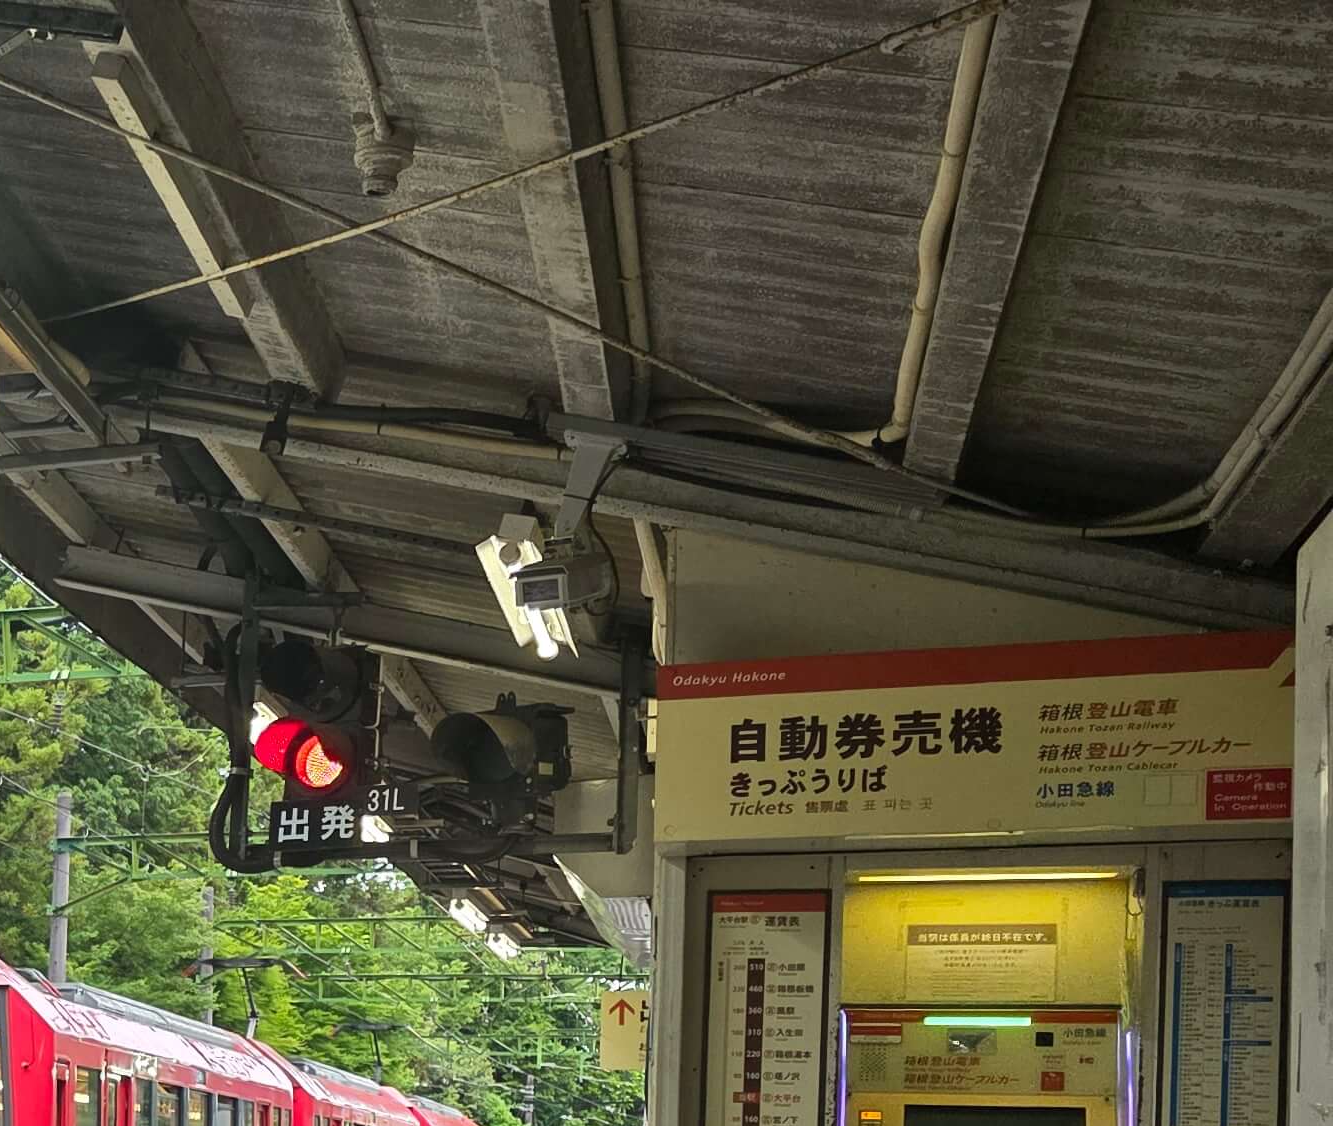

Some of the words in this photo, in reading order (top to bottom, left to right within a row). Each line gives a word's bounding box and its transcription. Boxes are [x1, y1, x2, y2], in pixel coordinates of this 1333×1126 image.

[673, 674, 727, 687] Odakyu
[733, 671, 786, 683] Hakone
[1038, 698, 1180, 722] 箱根登山電車
[730, 706, 1003, 763] 自動券売機
[1040, 725, 1084, 735] Hakone
[1089, 723, 1123, 733] Tozan
[1127, 720, 1175, 732] Railway
[1037, 736, 1252, 762] 箱根登山ケーブルカー
[1038, 765, 1083, 775] Hakone
[1088, 763, 1122, 773] Tozan
[1127, 761, 1178, 771] Cablecar
[730, 765, 888, 797] きっぷうりば
[1037, 780, 1115, 799] 小田急線
[367, 787, 405, 812] 31L
[729, 801, 794, 816] Tickets
[278, 804, 355, 843] 出発
